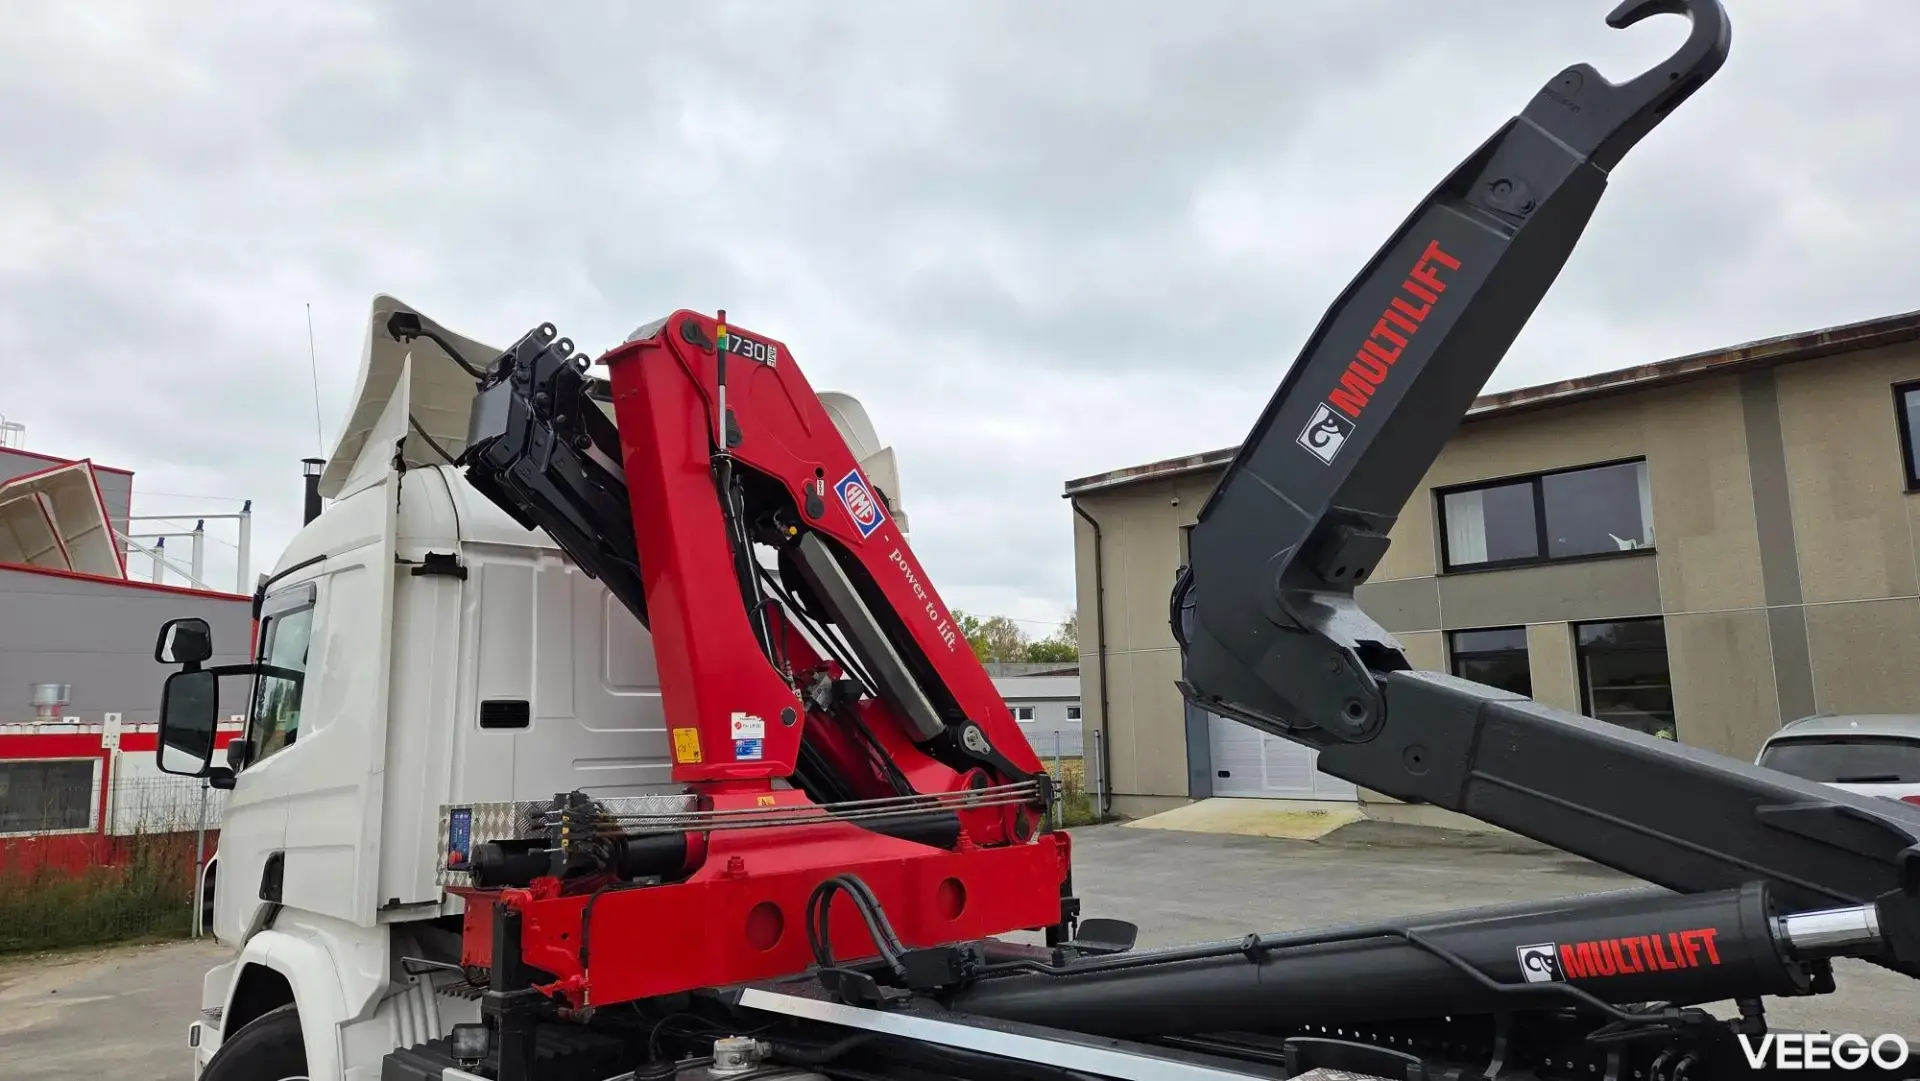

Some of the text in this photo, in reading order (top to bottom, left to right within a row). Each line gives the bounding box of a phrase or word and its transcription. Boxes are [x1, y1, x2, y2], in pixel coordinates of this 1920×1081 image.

[725, 333, 765, 361] 1730
[1328, 239, 1462, 418] MULTILIFT
[847, 486, 873, 519] HMF
[889, 548, 927, 600] power
[925, 601, 939, 621] to
[936, 621, 957, 652] lift.
[1560, 928, 1721, 979] MULTILIFT
